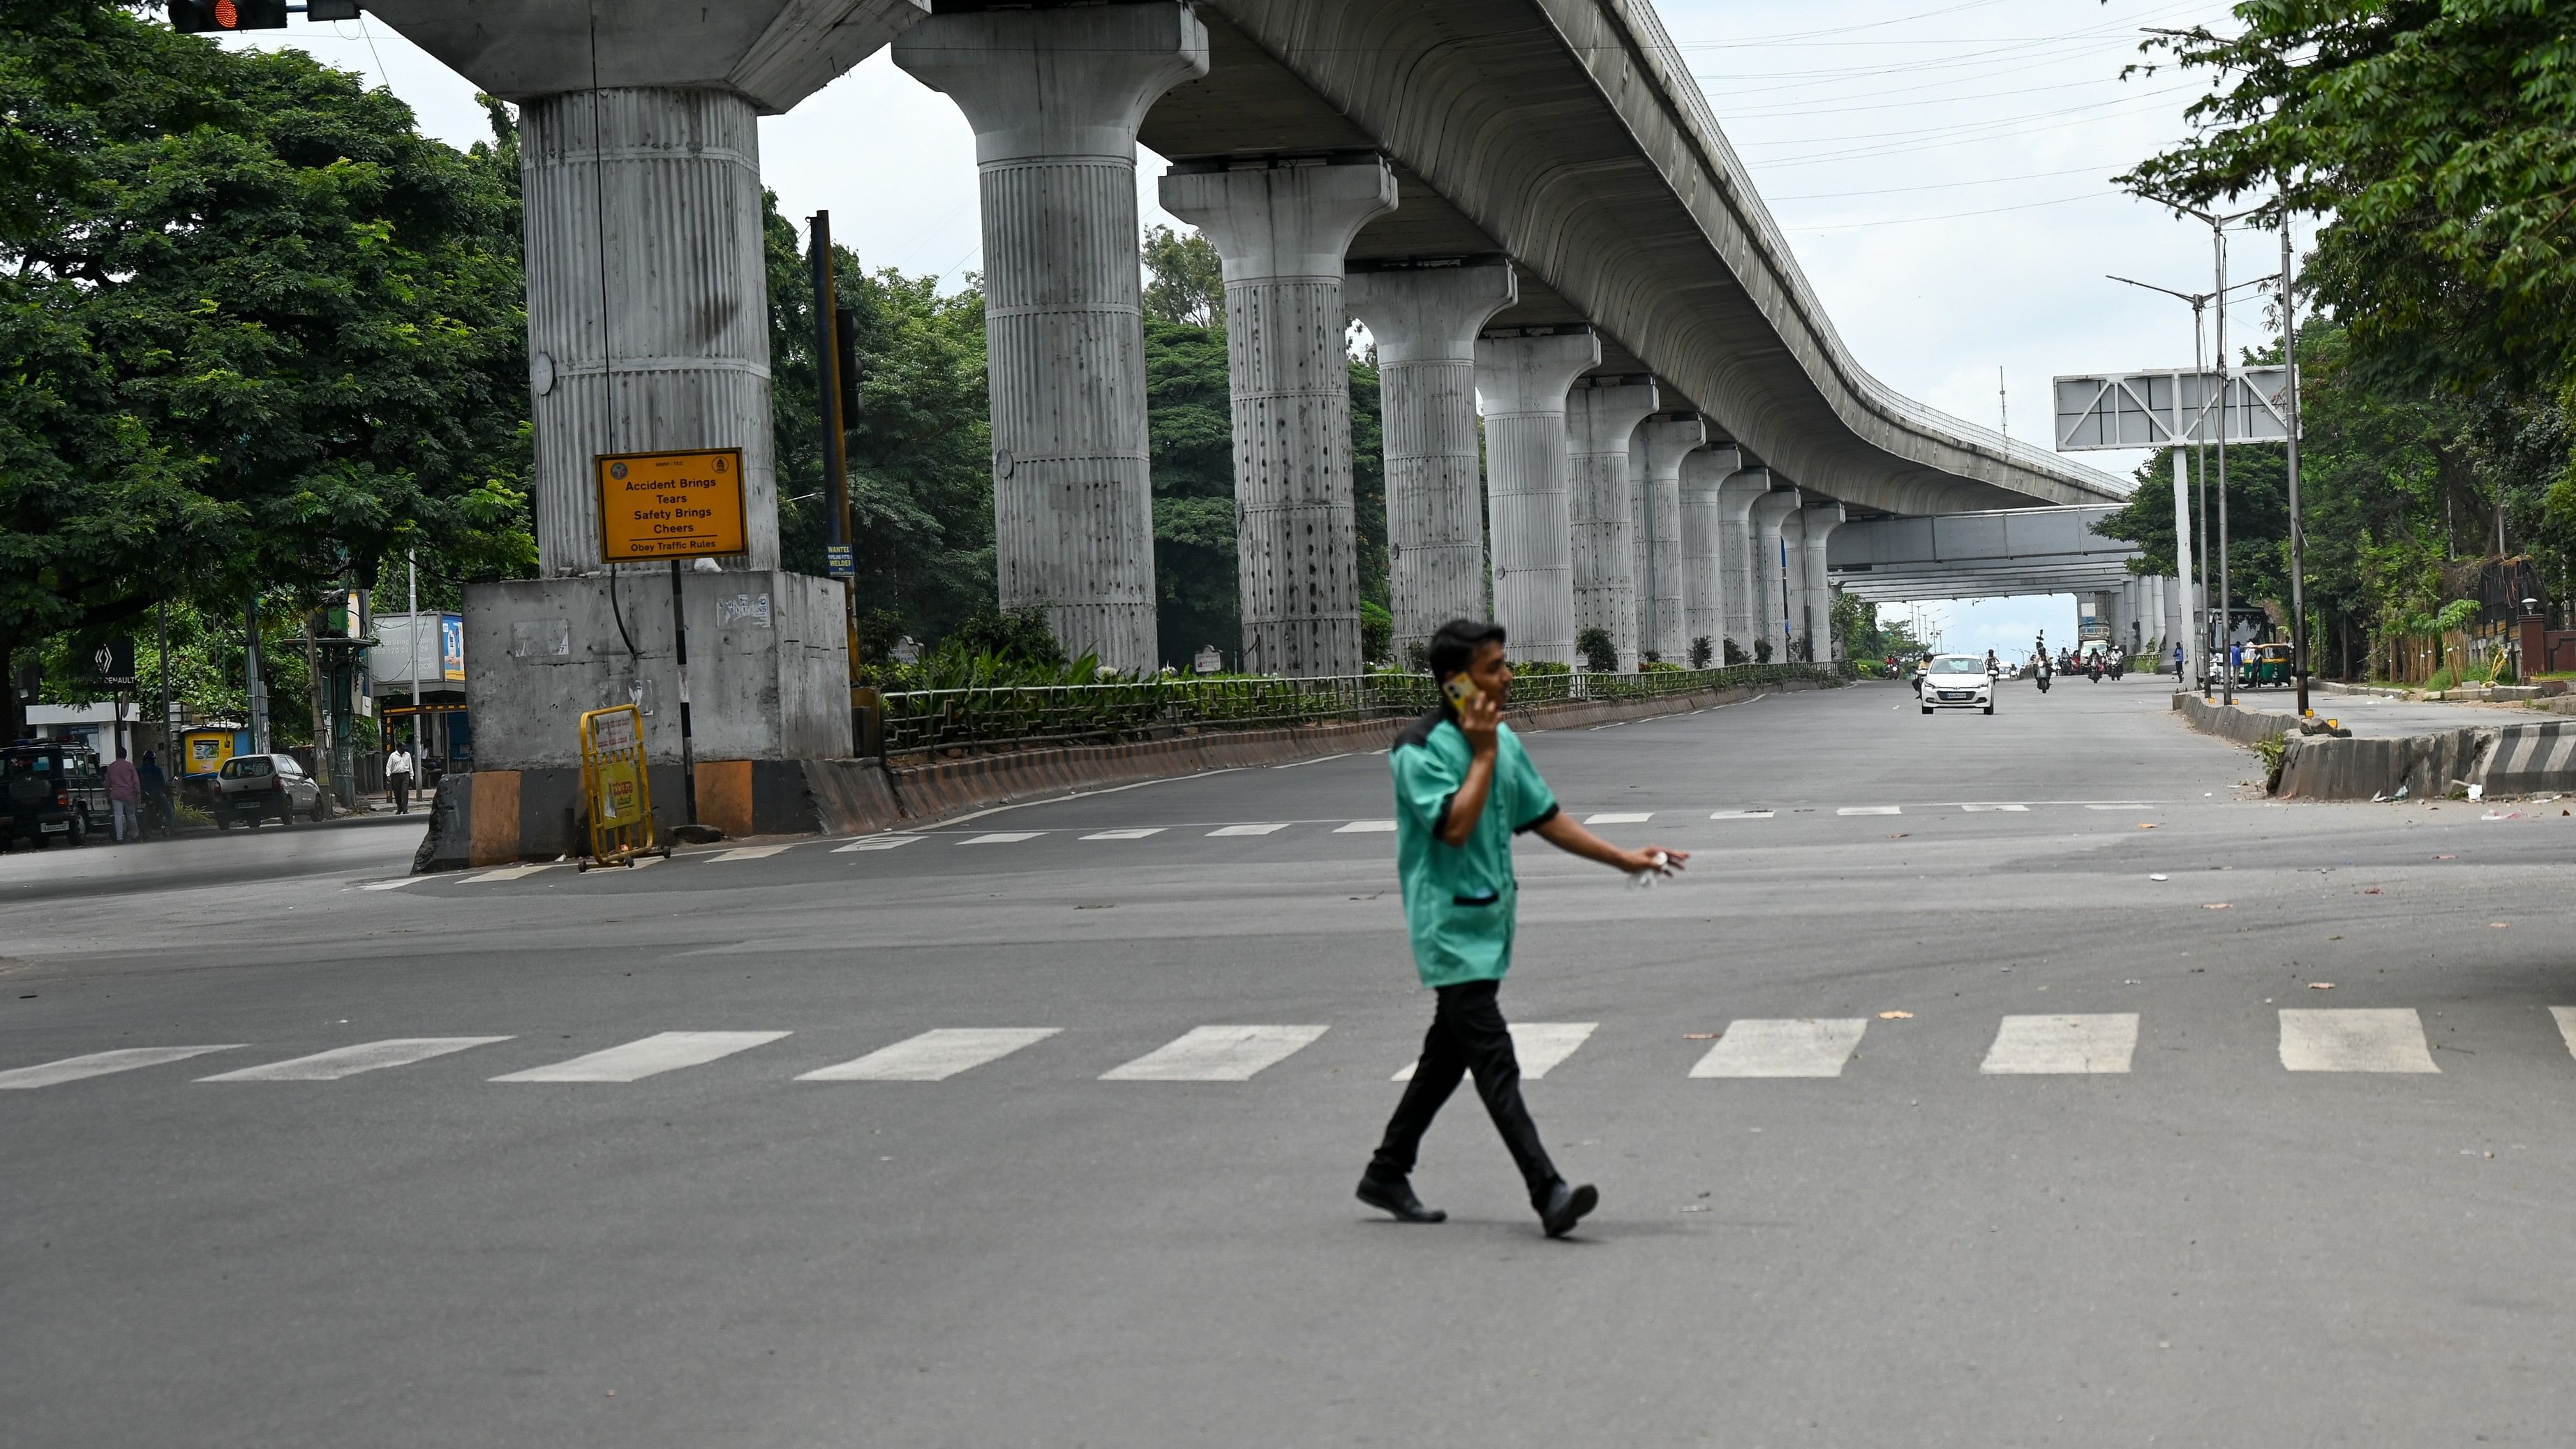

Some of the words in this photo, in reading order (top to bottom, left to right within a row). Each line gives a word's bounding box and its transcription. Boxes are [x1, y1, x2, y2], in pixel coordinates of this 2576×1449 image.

[625, 479, 676, 491] Accident
[680, 478, 717, 489] Brings
[656, 494, 687, 504] Tears
[634, 510, 671, 520] Safety
[676, 507, 712, 519] Brings
[653, 523, 694, 534] Cheers
[631, 542, 655, 552] Obey
[657, 541, 687, 550] Traffic
[690, 540, 716, 549] Rules
[417, 637, 435, 645] quiry
